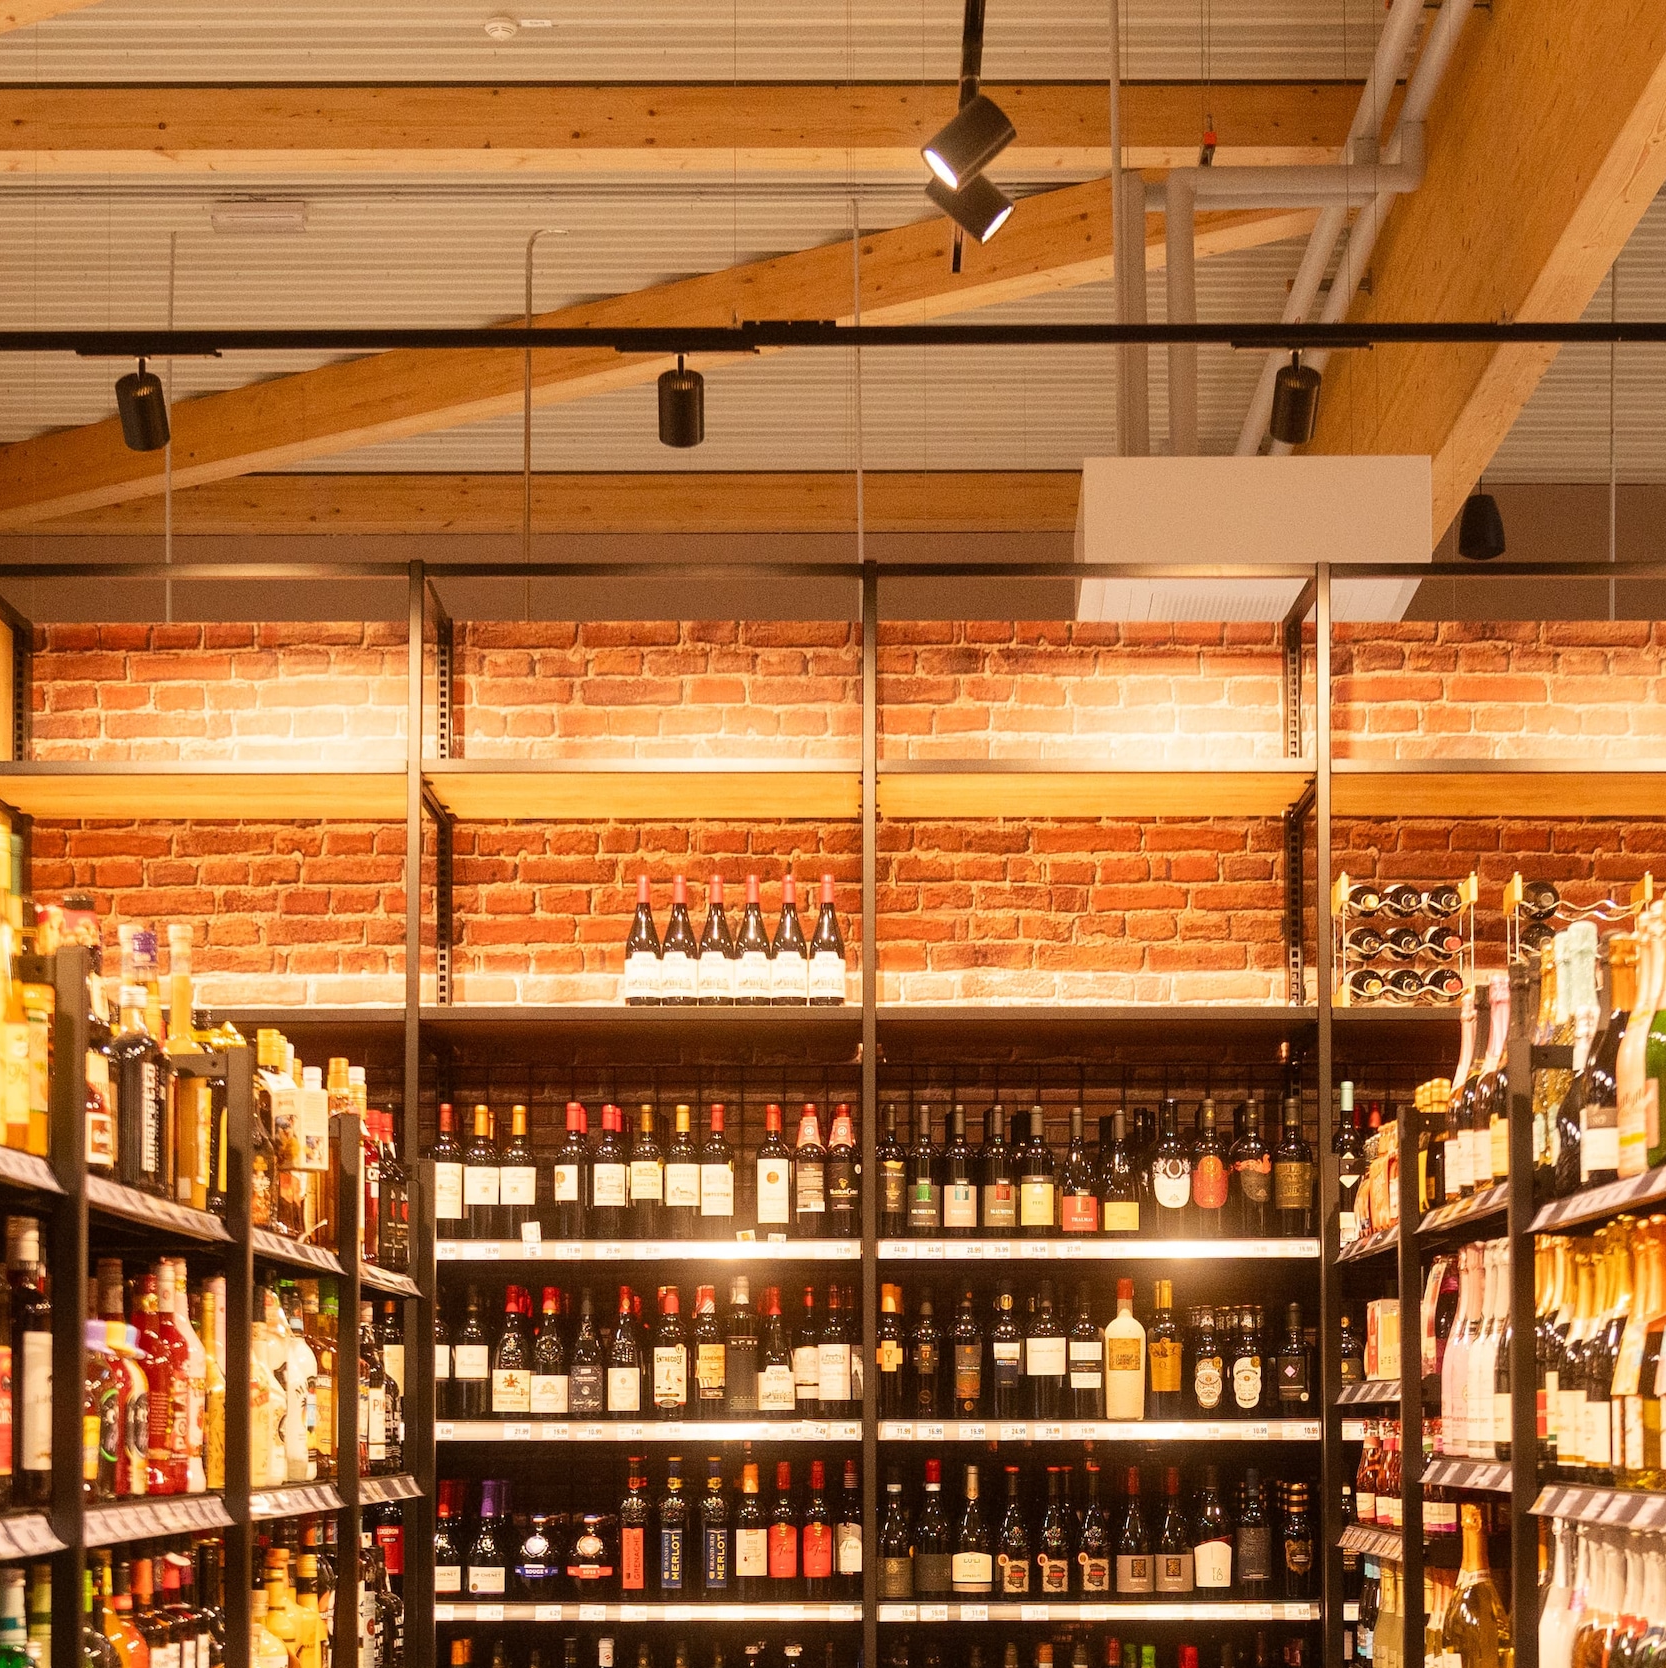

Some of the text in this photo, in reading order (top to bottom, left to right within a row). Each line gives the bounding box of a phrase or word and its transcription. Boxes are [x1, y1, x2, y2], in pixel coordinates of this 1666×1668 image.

[142, 1062, 158, 1172] amaretto
[634, 1536, 642, 1581] GRENACHE
[671, 1534, 680, 1580] MERLOT
[716, 1534, 725, 1580] MERLOT
